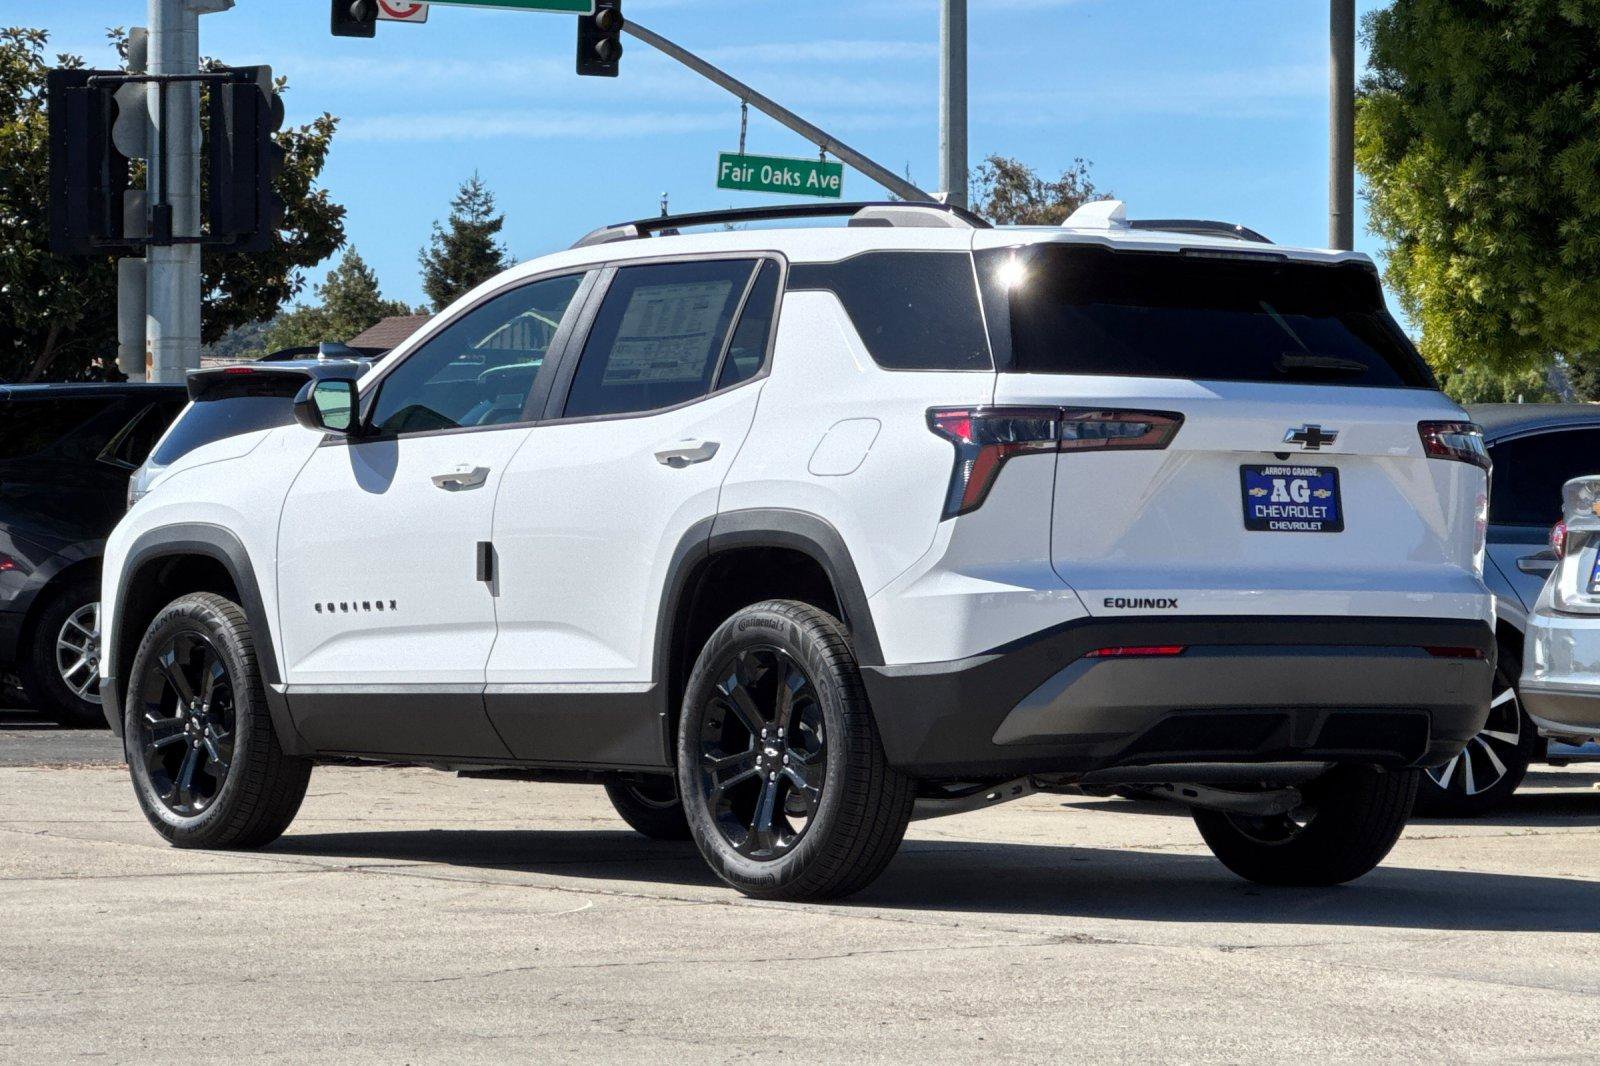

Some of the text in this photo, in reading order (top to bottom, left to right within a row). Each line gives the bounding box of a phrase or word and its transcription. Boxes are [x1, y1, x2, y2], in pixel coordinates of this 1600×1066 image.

[721, 162, 840, 189] Fair Oaks Ave
[1265, 467, 1317, 477] ARROYO GRANDE
[1270, 479, 1311, 503] AG
[1255, 505, 1327, 518] CHEVROLET
[1269, 521, 1322, 530] CHEVROLET
[314, 599, 397, 613] EQUINOX
[1103, 597, 1178, 609] EQUINOX
